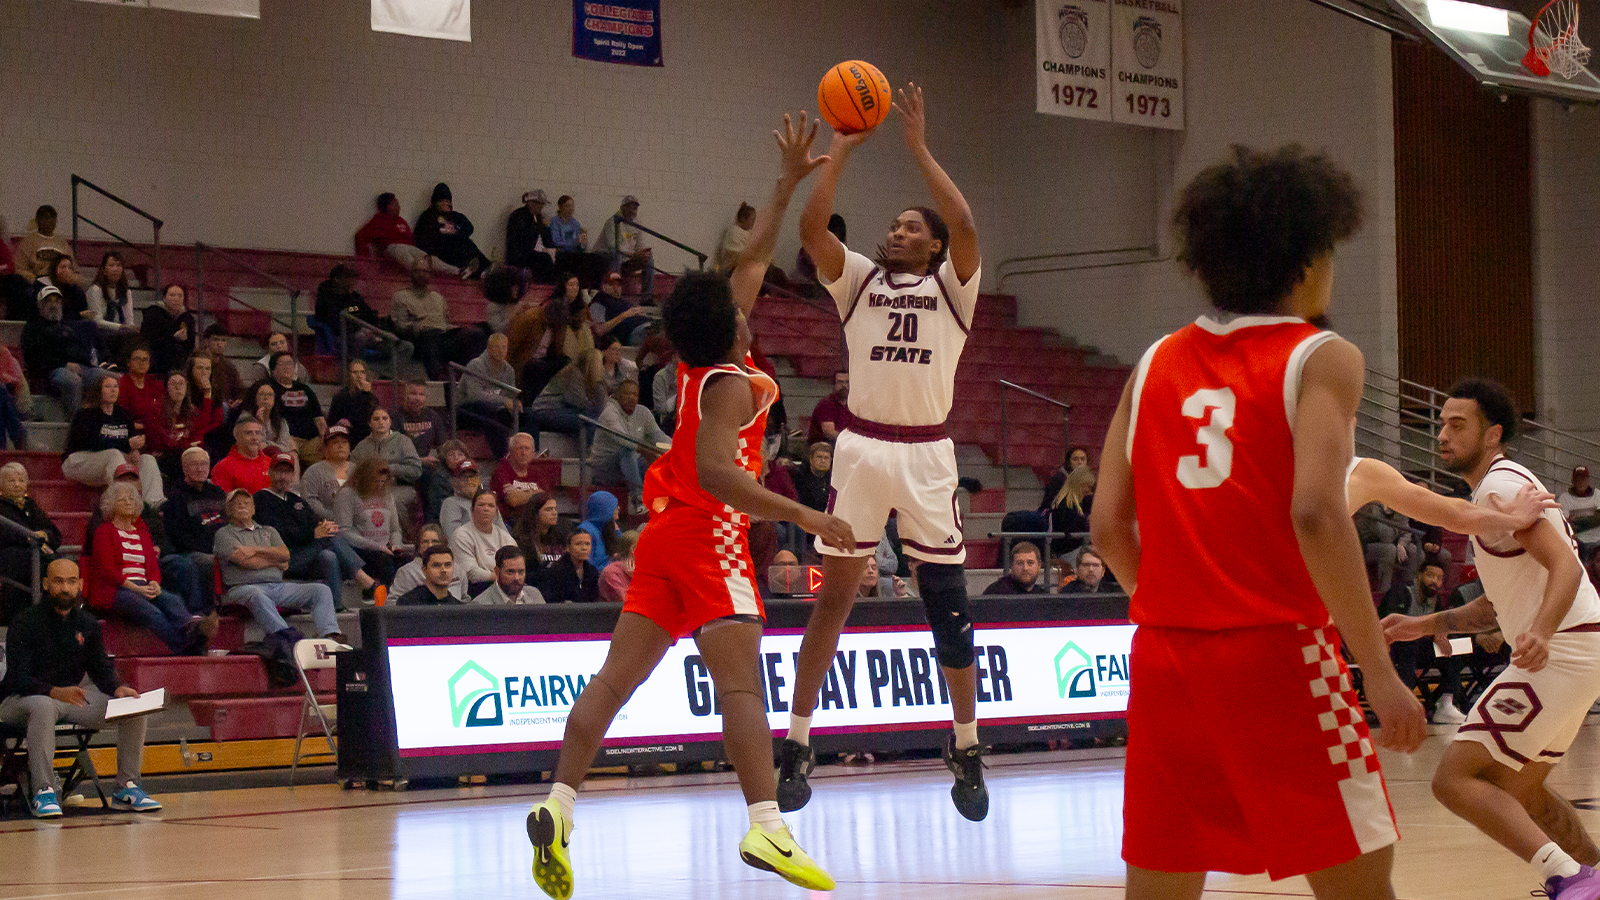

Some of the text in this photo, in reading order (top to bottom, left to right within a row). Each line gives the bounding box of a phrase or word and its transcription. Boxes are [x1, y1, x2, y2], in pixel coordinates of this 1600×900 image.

[584, 2, 654, 22] COLLEGIATE
[584, 18, 653, 37] CHAMPIONS
[1043, 60, 1106, 79] CHAMPIONS
[1118, 71, 1178, 89] CHAMPIONS
[849, 66, 875, 112] Wilson
[1052, 83, 1098, 109] 1972
[1126, 93, 1170, 118] 1973
[869, 292, 938, 311] HENDERSON
[887, 312, 918, 342] 20
[870, 346, 932, 365] STATE
[1176, 387, 1236, 489] 3
[684, 653, 788, 717] GE
[866, 645, 1013, 707] PARTER
